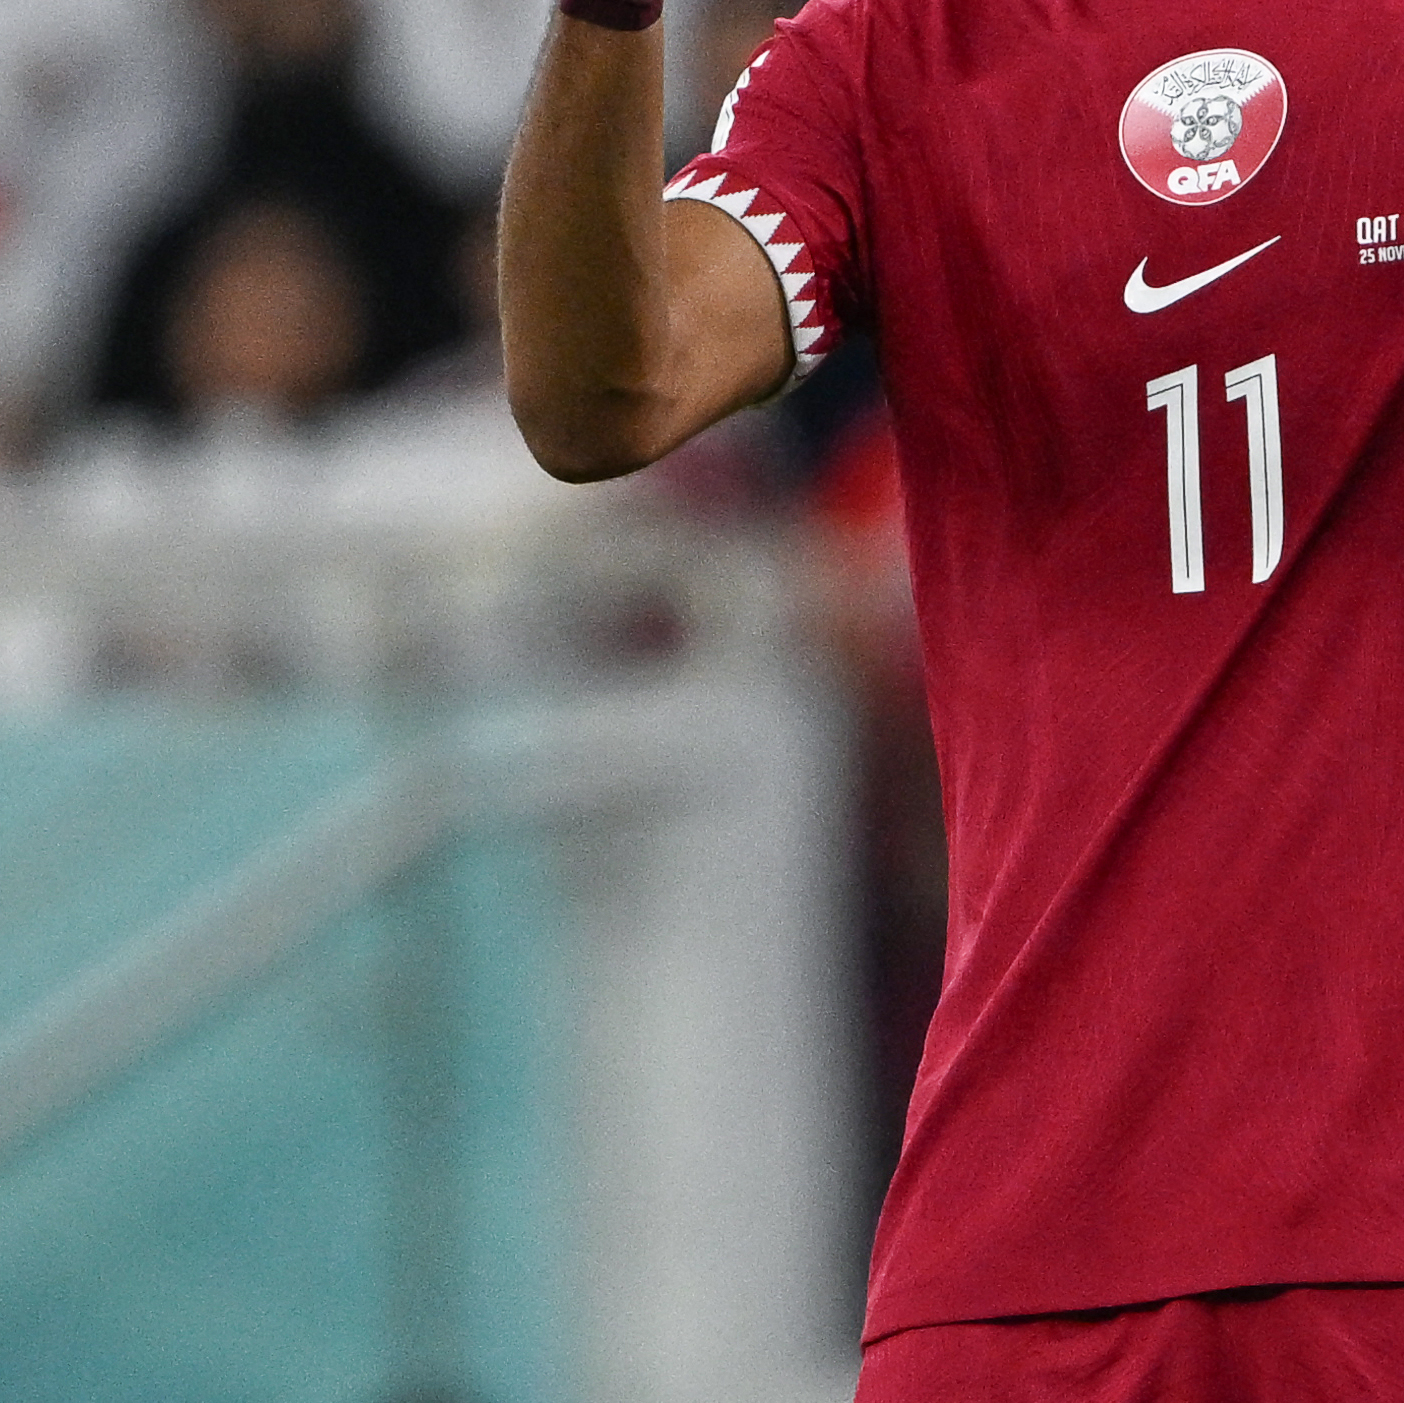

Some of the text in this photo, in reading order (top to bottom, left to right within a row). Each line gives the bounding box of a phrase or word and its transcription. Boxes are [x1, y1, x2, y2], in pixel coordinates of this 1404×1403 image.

[1167, 159, 1241, 196] QFA
[1356, 213, 1400, 245] QAT
[1359, 247, 1376, 265] 25
[1146, 353, 1284, 594] 11
